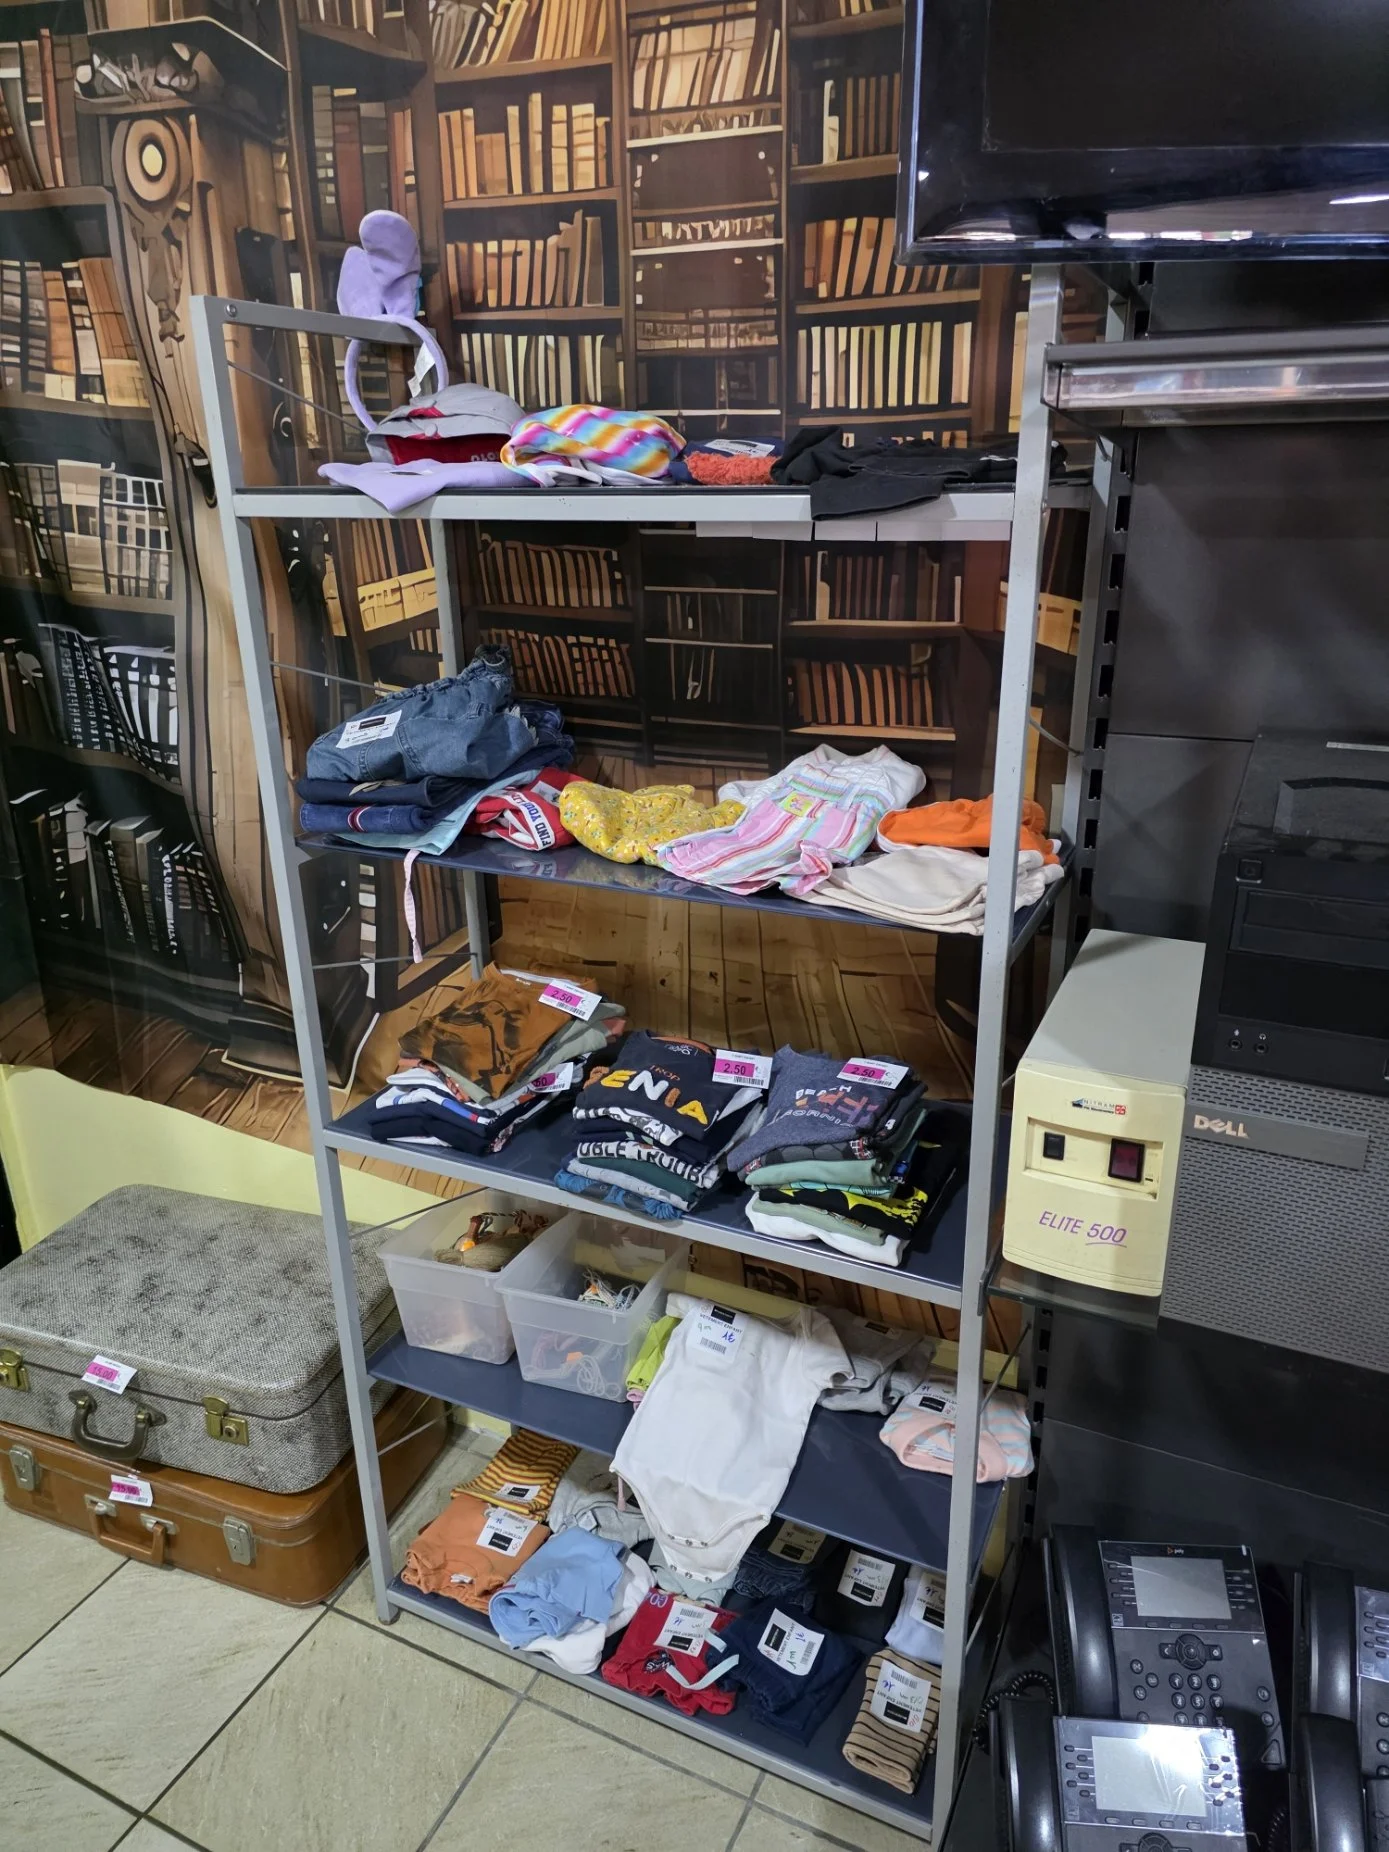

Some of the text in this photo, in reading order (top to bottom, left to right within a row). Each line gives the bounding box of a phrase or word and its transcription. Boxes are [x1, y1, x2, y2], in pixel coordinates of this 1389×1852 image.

[533, 822, 552, 847] FIND
[551, 990, 573, 1004] 2.50
[723, 1063, 747, 1075] 2.50
[851, 1066, 876, 1078] 2.50
[1083, 1099, 1115, 1109] NITRAM
[1194, 1114, 1249, 1139] DELL
[1039, 1210, 1127, 1243] ELITE 500
